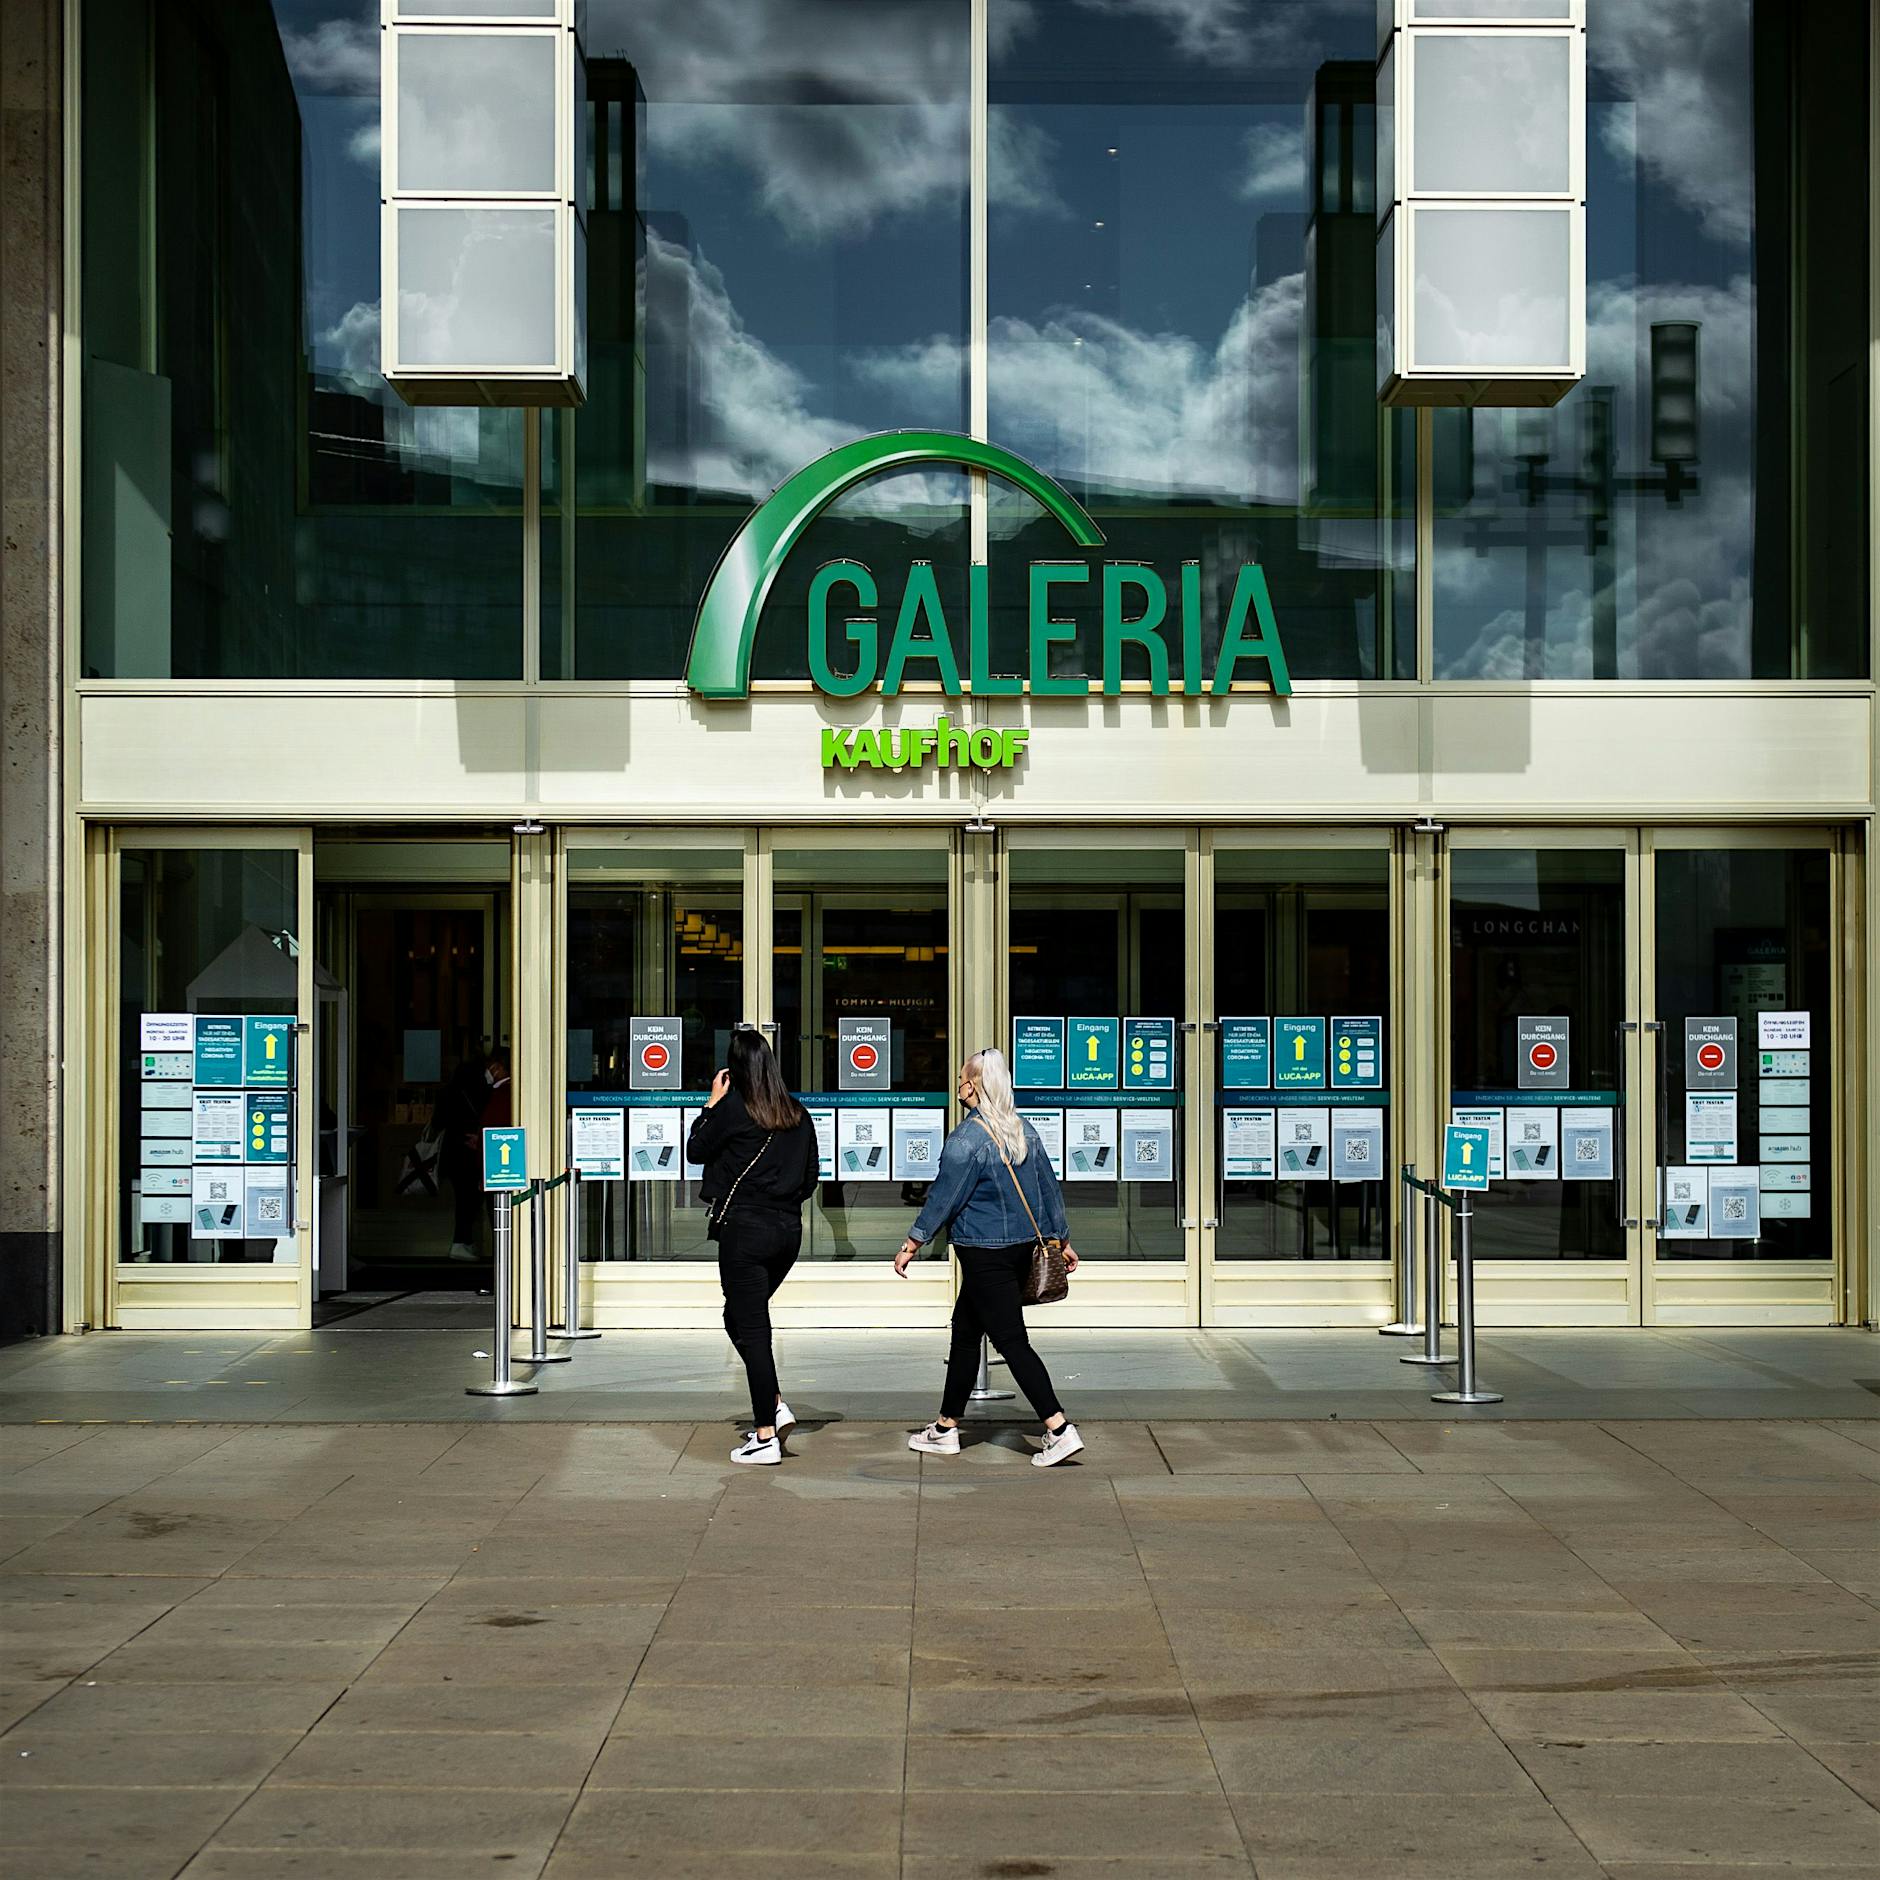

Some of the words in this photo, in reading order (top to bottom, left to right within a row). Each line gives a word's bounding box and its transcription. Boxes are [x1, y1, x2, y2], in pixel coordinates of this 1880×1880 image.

[808, 563, 1293, 697] GALERIA
[834, 998, 875, 1007] TOMMY
[889, 998, 935, 1007] HILFIGER
[255, 1022, 288, 1031] Eingang
[1077, 1024, 1110, 1033] Eingang
[1284, 1024, 1316, 1033] Eingang
[1454, 1131, 1482, 1141] Eingang
[1447, 1174, 1485, 1182] LUCA-APP
